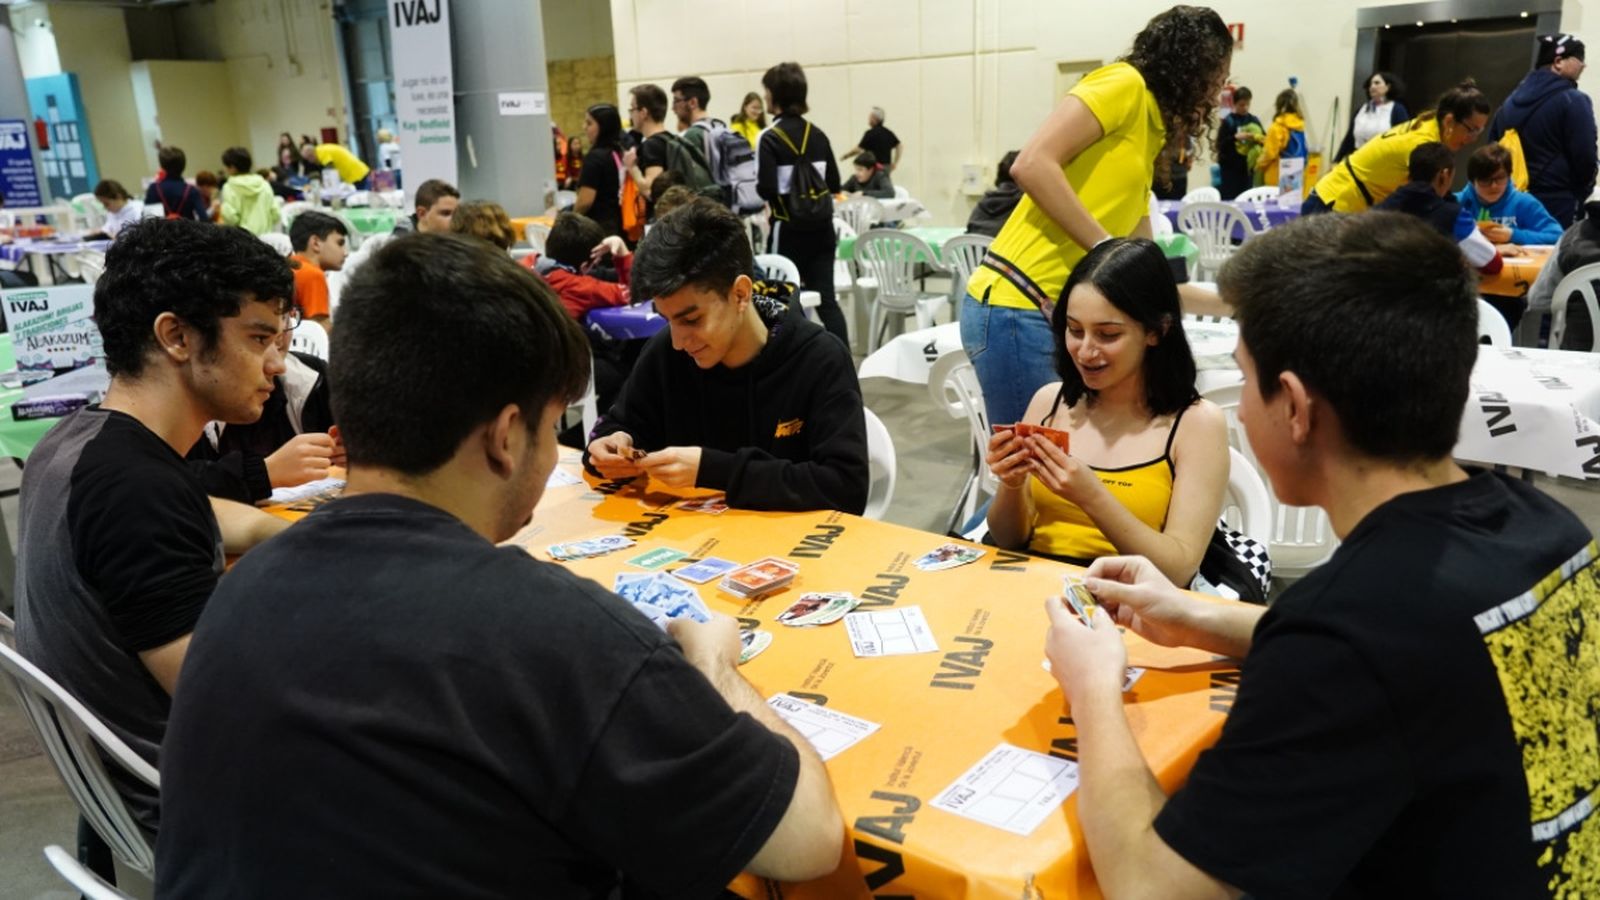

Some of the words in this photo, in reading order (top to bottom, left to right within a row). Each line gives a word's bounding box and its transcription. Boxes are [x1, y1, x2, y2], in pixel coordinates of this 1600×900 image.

[394, 0, 441, 28] IVAJ
[0, 133, 26, 150] VAJ
[10, 300, 49, 313] IVAJ
[788, 524, 846, 558] IVAJ
[930, 636, 994, 690] IVAJ
